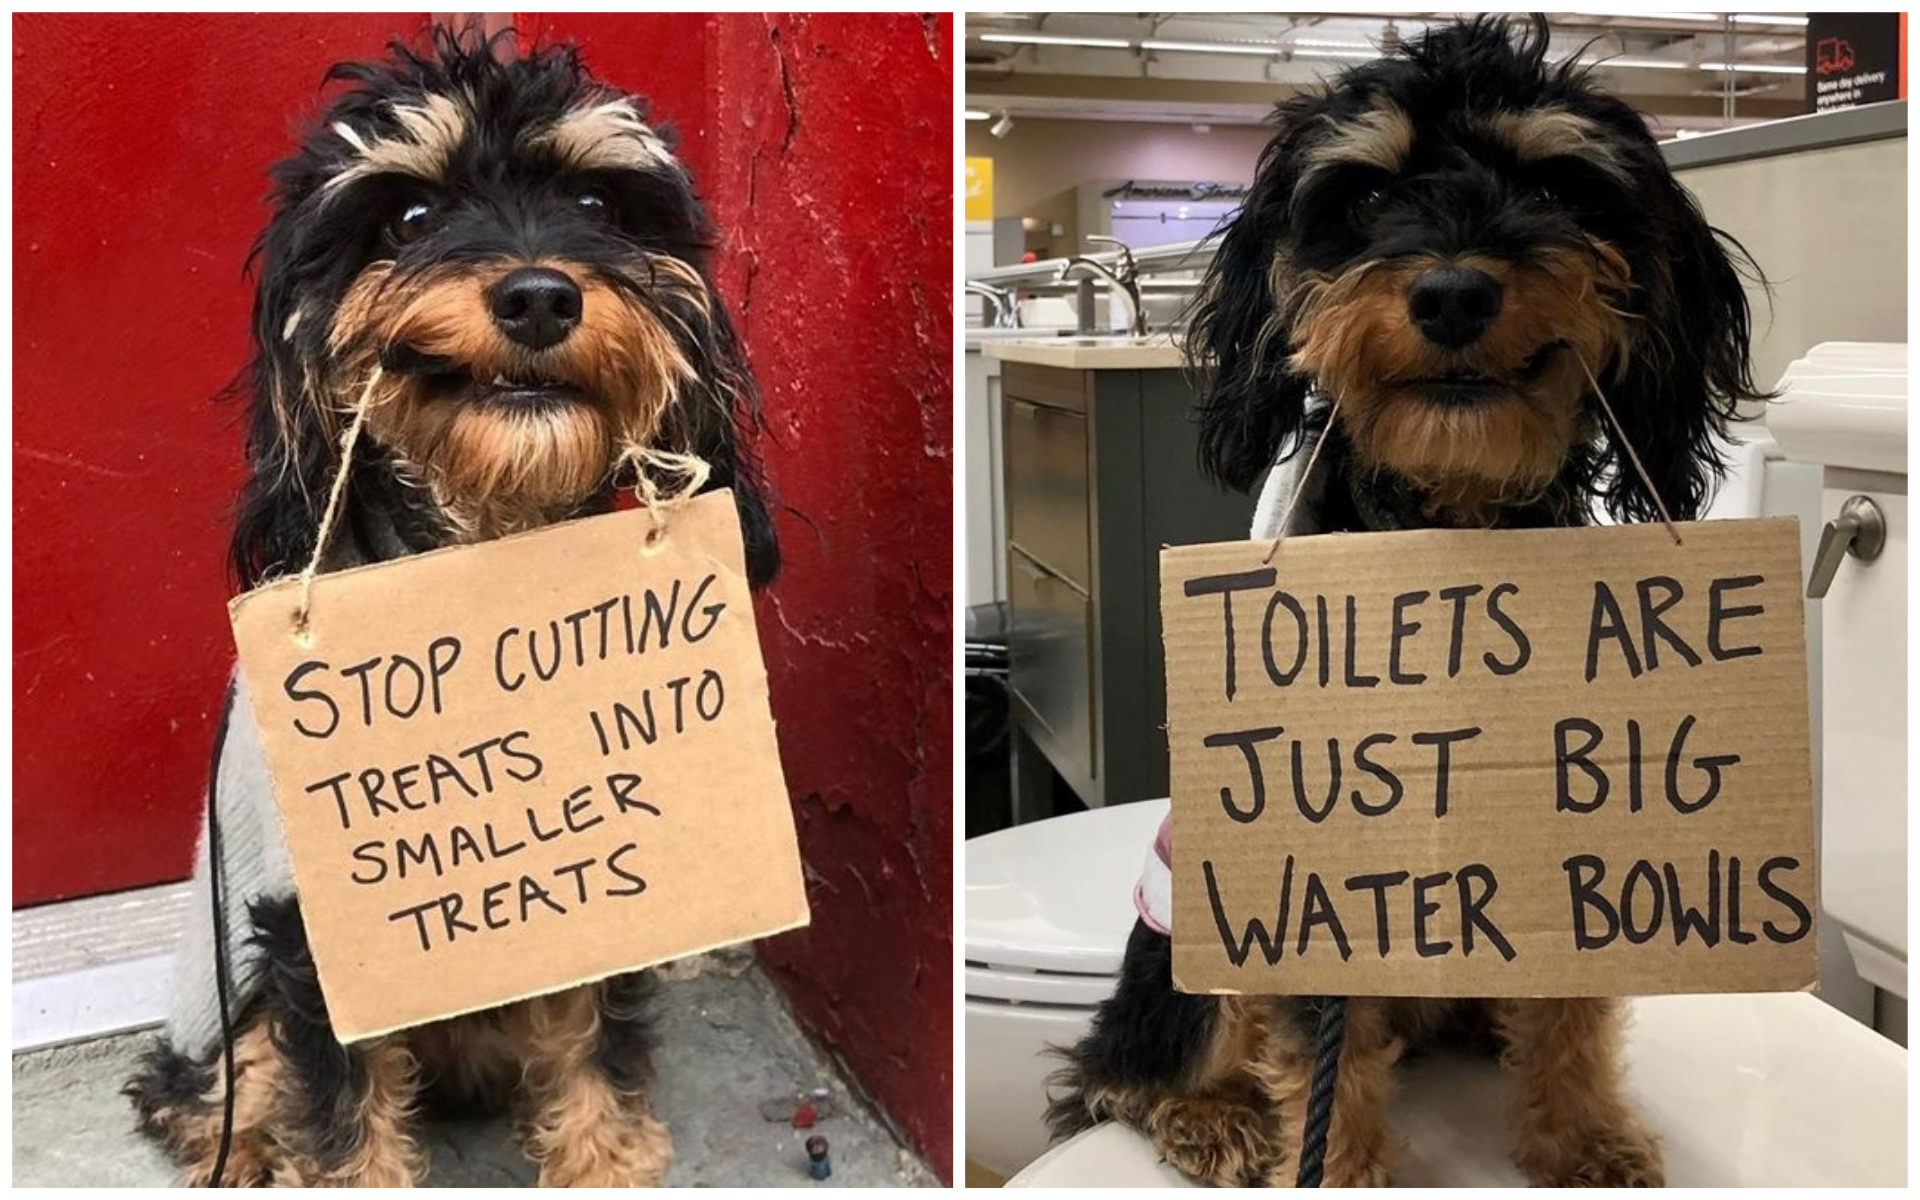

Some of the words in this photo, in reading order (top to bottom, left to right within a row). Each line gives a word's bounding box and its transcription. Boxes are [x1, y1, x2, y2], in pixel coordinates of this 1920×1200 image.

[1817, 81, 1838, 93] Same
[1839, 78, 1852, 89] day
[1854, 73, 1885, 86] delivery
[1817, 92, 1851, 105] anywhere
[1103, 180, 1192, 198] American
[284, 637, 461, 738] STOP
[494, 574, 726, 691] CUTTING
[1184, 568, 1531, 702] TOILETS
[1585, 575, 1765, 683] ARE
[305, 731, 543, 828] TREATS
[590, 670, 724, 755] INTO
[1203, 726, 1481, 824] JUST
[1554, 715, 1741, 814] BIG
[351, 773, 661, 884] SMALLER
[388, 843, 647, 951] TREATS
[1203, 855, 1517, 967] WATER
[1562, 849, 1812, 950] BOWLS
